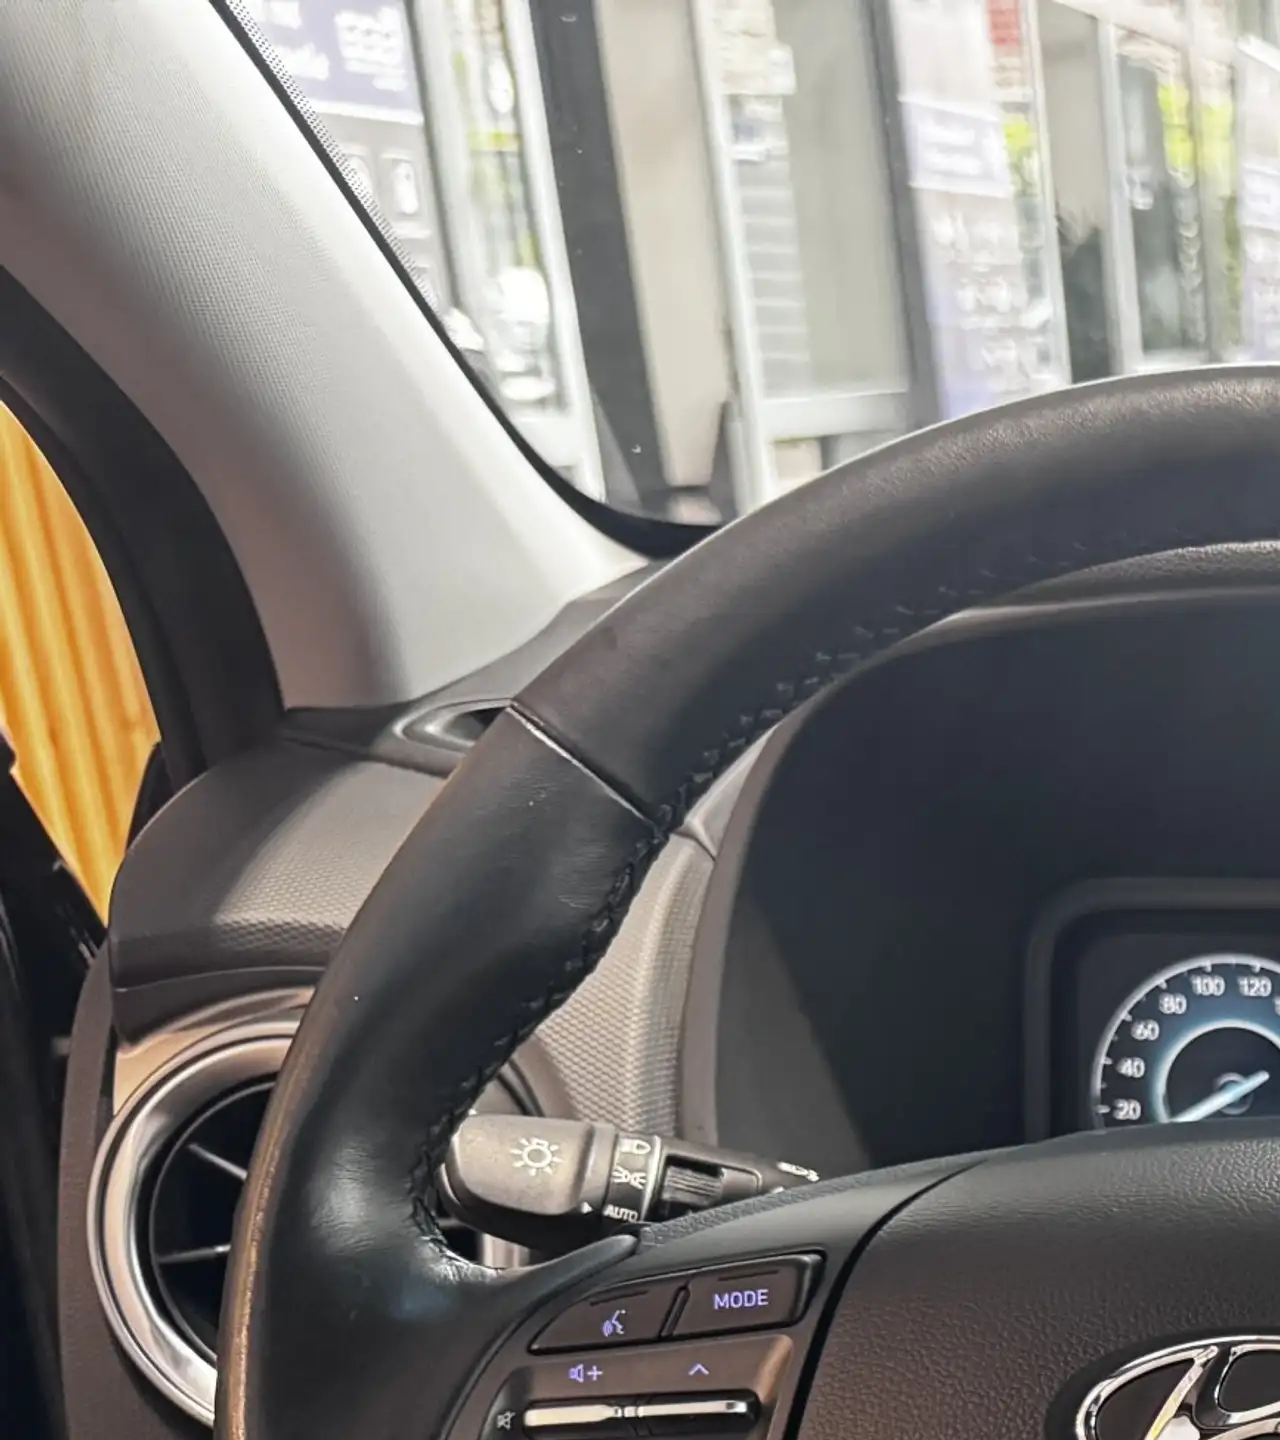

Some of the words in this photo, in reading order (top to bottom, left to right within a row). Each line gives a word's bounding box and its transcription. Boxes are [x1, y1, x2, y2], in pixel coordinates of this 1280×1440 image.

[1192, 976, 1225, 997] 100
[1237, 976, 1272, 997] 120
[1158, 994, 1188, 1015] 80
[1131, 1021, 1160, 1042] 60
[1117, 1059, 1146, 1080] 40
[1112, 1101, 1142, 1121] 20
[604, 1203, 640, 1223] AUTO
[712, 1288, 770, 1311] MODE
